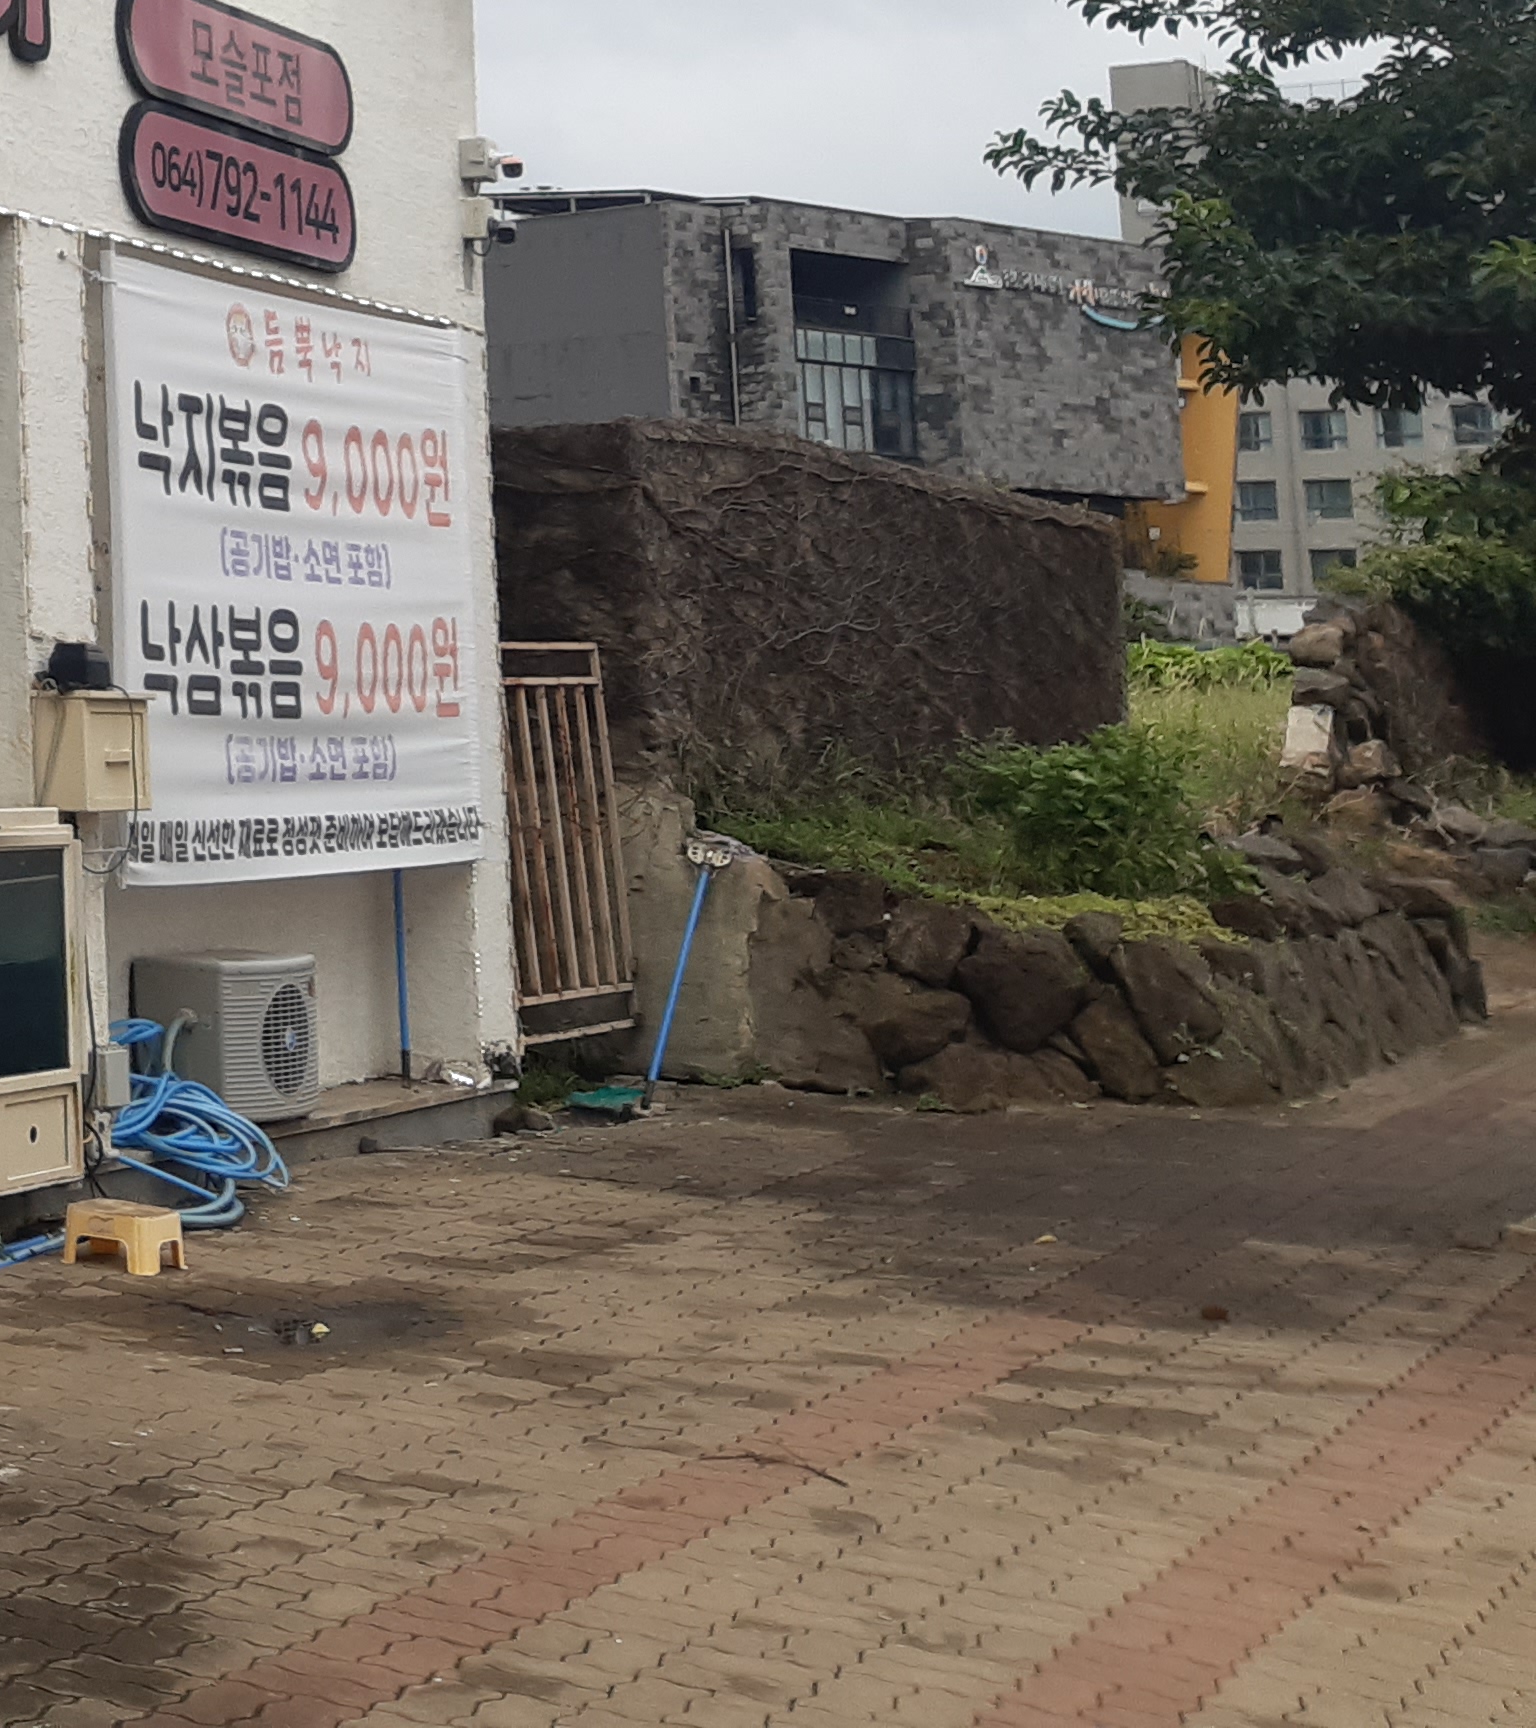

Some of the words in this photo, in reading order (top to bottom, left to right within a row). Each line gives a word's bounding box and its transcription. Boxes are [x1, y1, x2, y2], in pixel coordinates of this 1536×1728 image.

[190, 19, 303, 126] 모슬포점
[150, 140, 340, 245] 064)792-1144
[134, 379, 293, 512] 낙지볶음
[301, 418, 452, 528] 9,000원
[140, 599, 304, 720] 낙삼볶음
[314, 616, 461, 719] 9,000원
